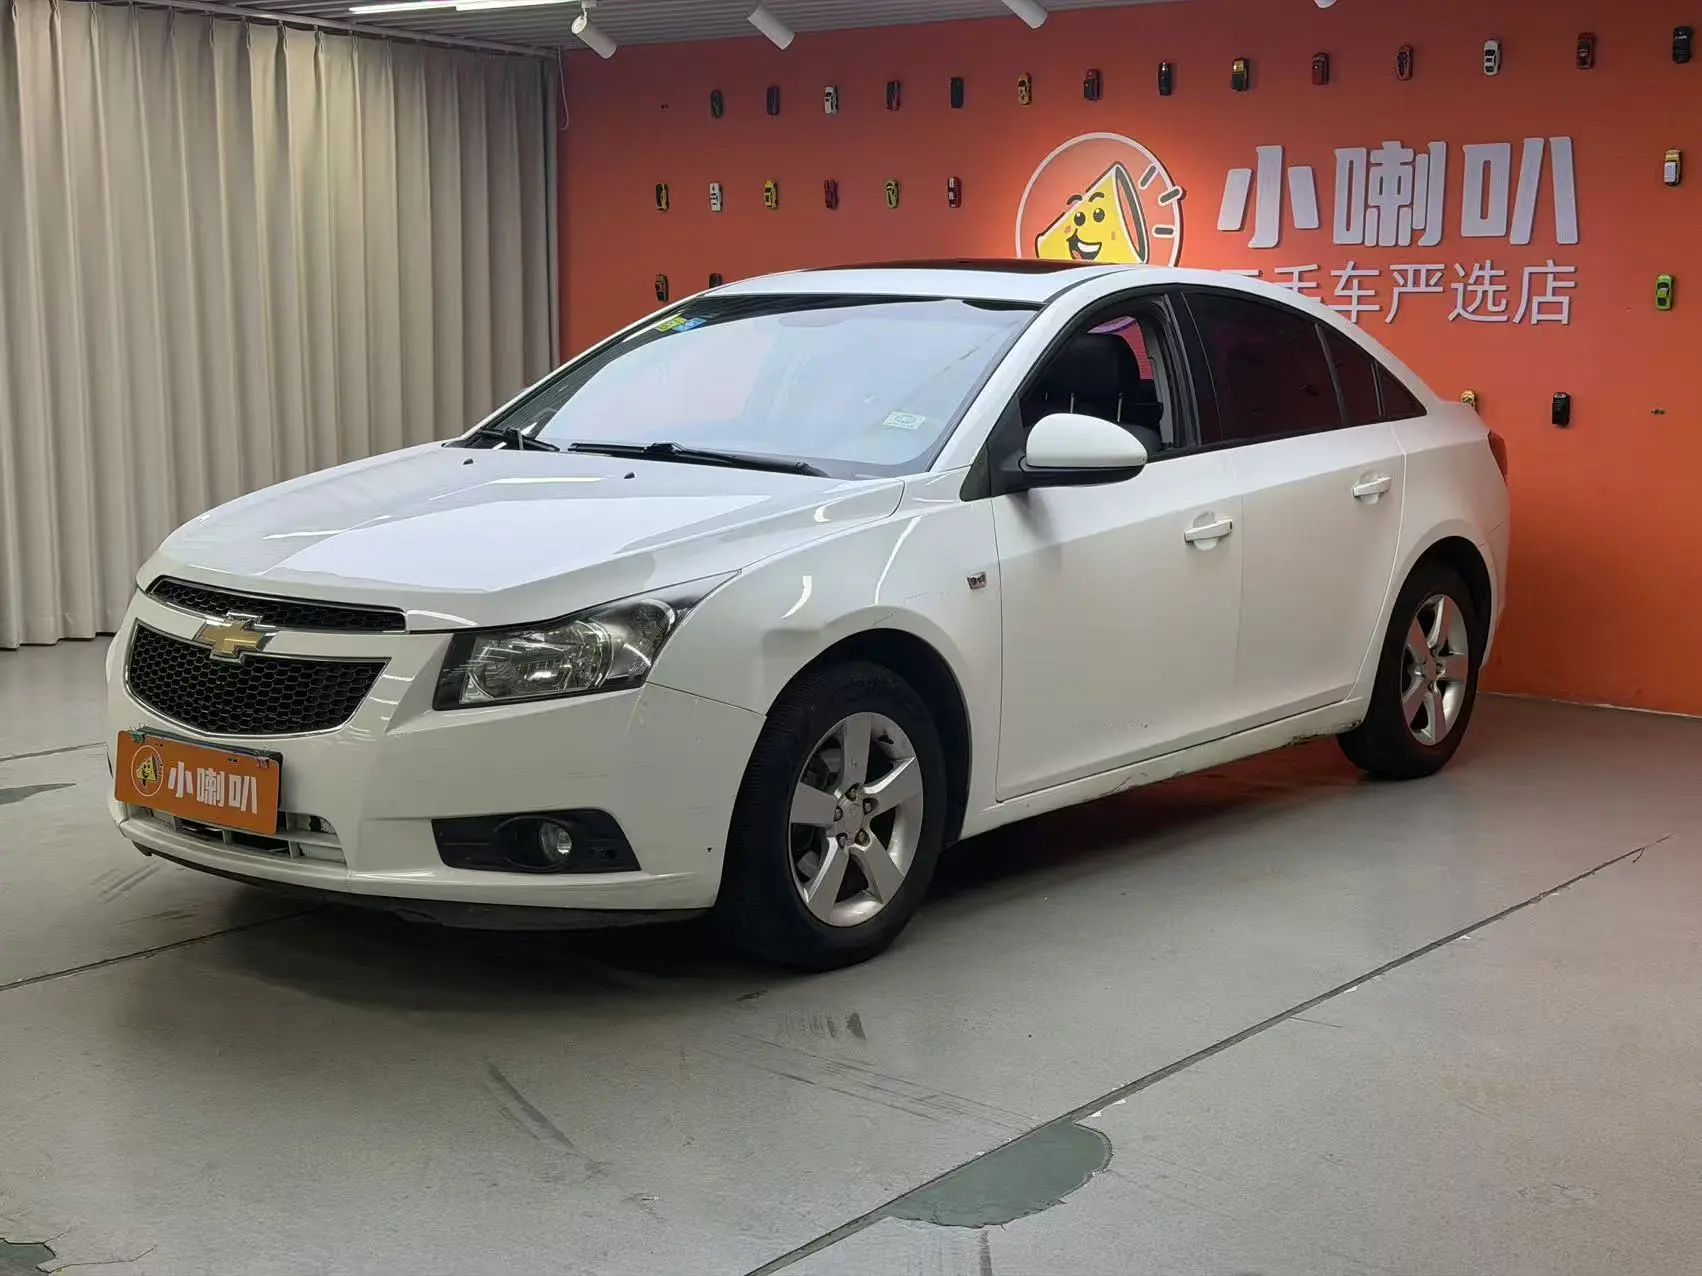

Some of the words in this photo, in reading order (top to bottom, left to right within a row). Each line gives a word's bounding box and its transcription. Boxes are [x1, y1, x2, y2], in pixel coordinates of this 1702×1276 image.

[1216, 135, 1580, 249] 小喇叭
[1218, 259, 1578, 326] 手车严选店
[167, 761, 258, 815] 小喇叭
